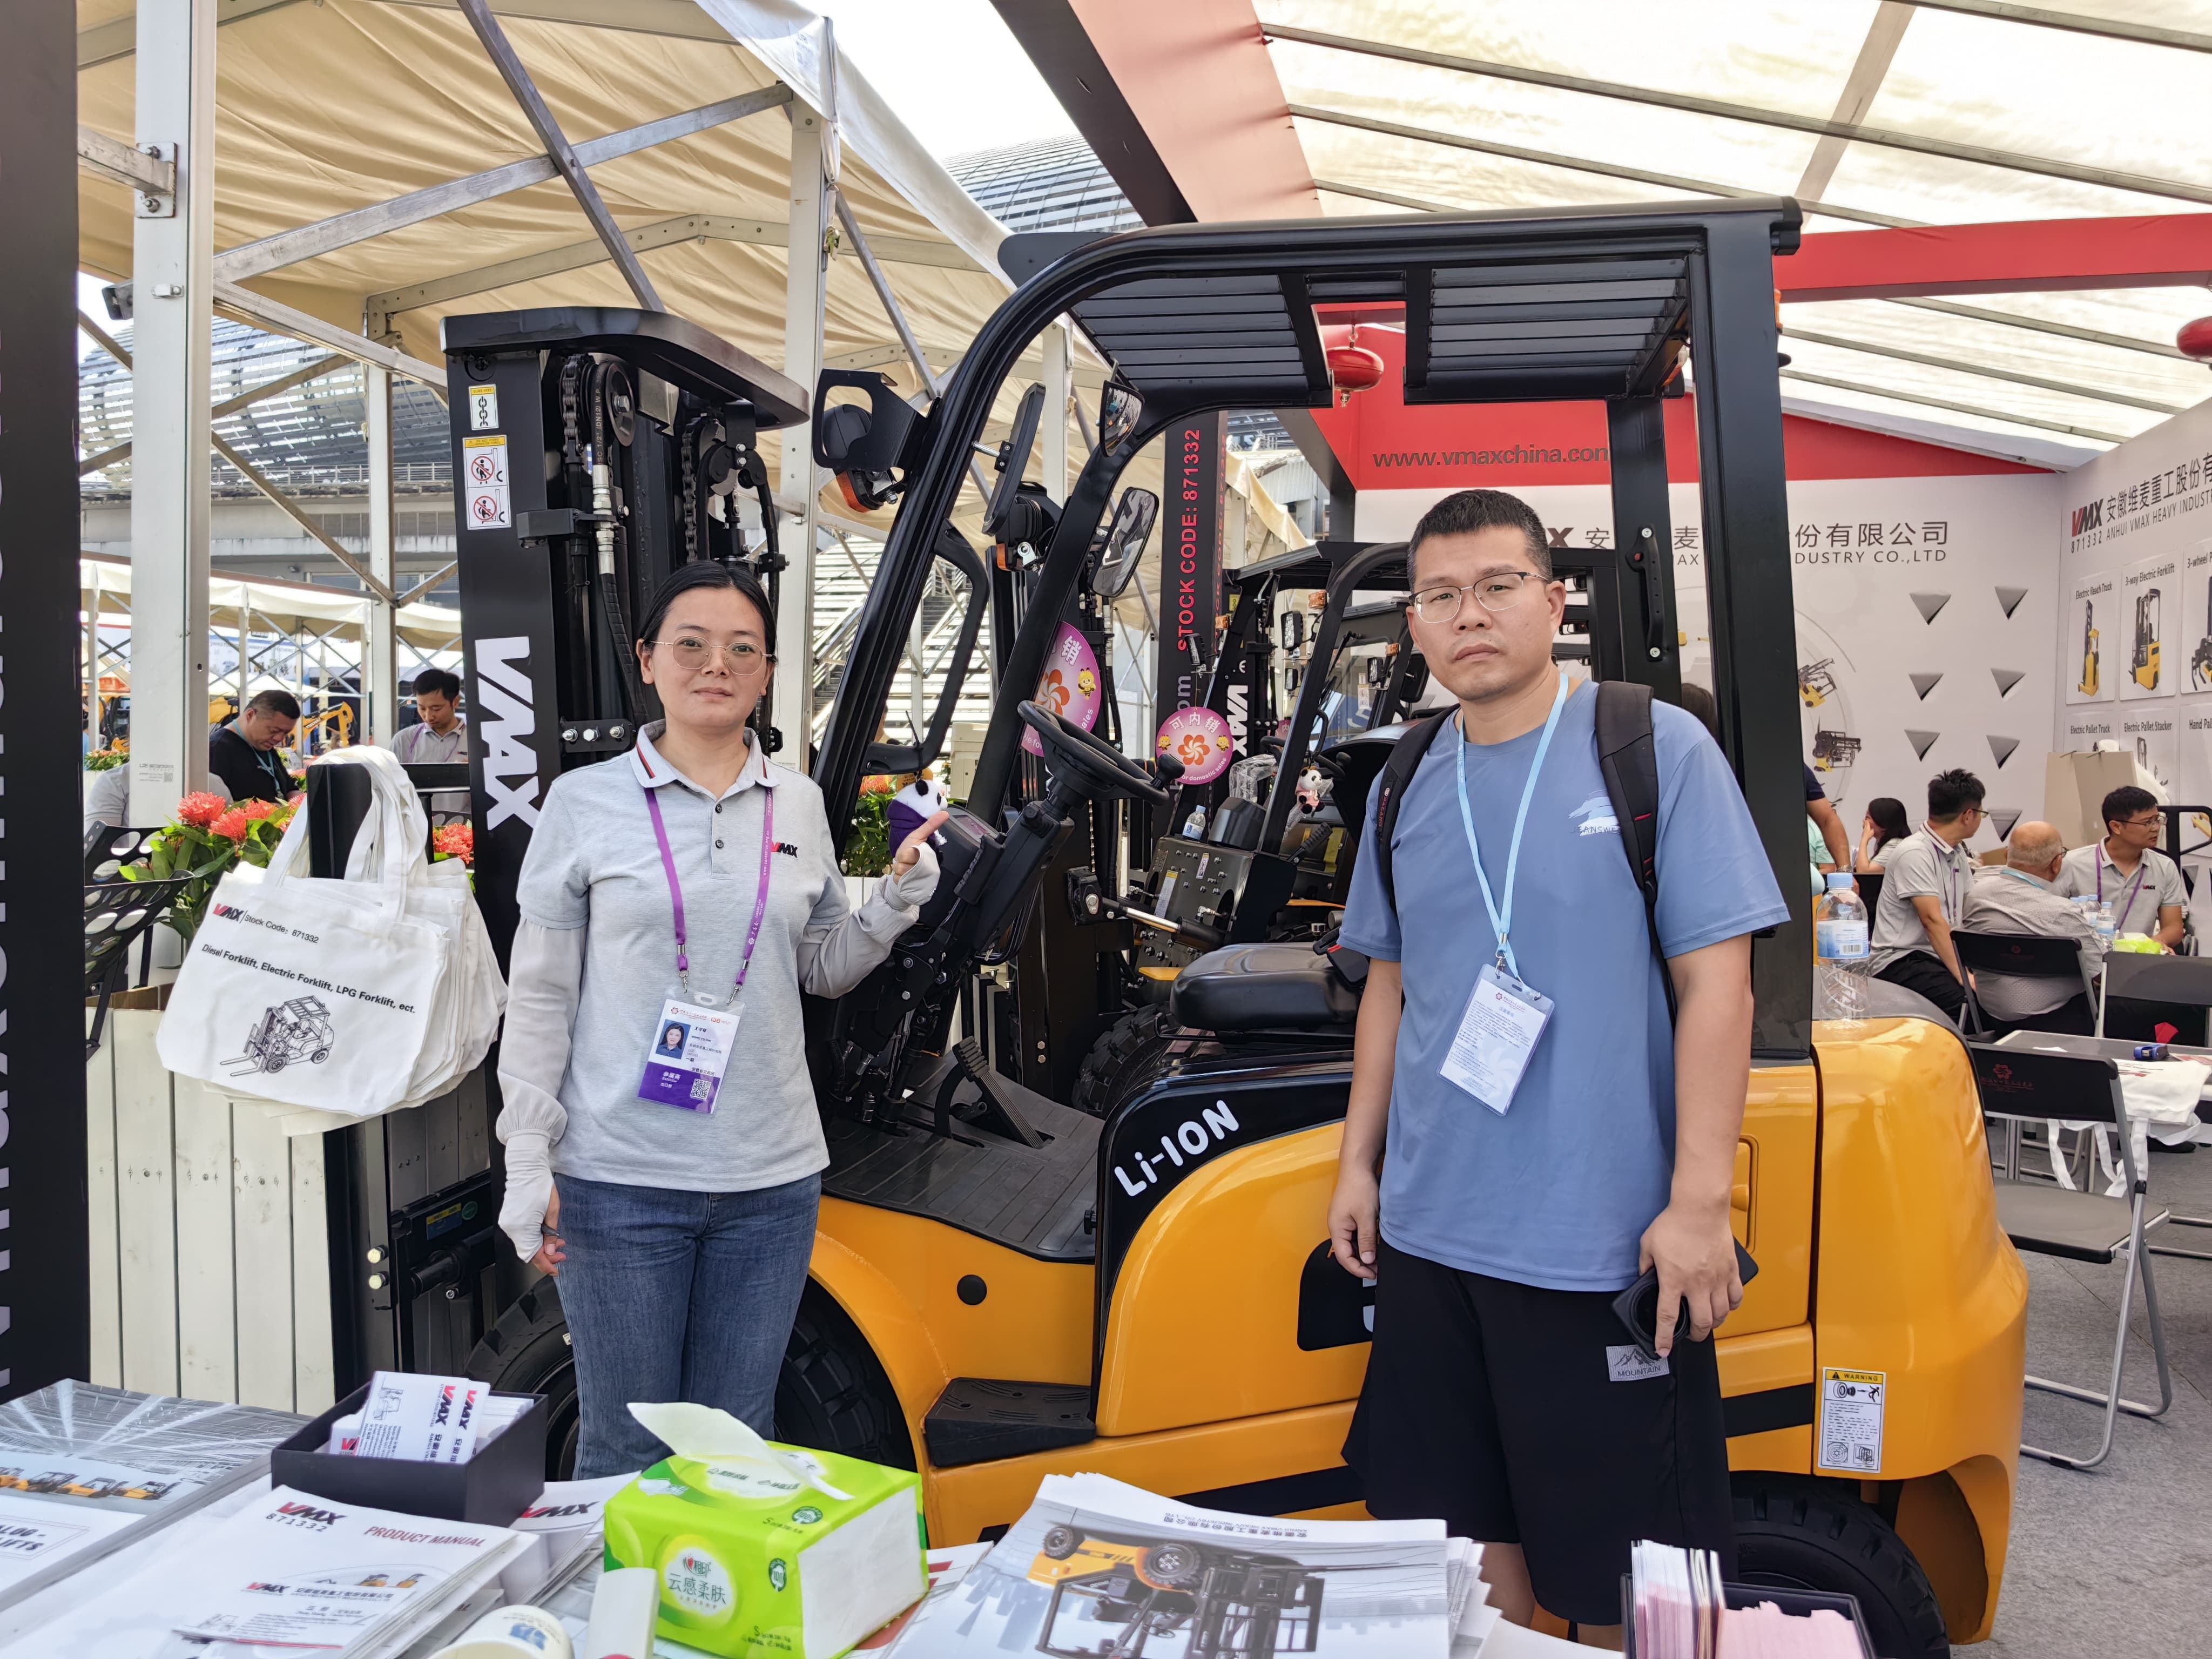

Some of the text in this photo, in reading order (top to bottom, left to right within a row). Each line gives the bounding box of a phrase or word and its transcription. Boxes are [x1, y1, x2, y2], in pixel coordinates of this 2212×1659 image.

[2107, 521, 2127, 540] ANHUI
[2130, 514, 2149, 532] VMAX
[2153, 502, 2177, 524] HEAVY
[1178, 430, 1199, 651] STOCK CODE: 871332
[2071, 531, 2102, 554] 871332
[1874, 550, 1946, 564] CO.,LTD
[2187, 552, 2208, 569] 3-wheel
[2126, 563, 2175, 586] 3-way Electric Forklift
[2075, 581, 2112, 599] Electric Reach Truck
[1082, 709, 1094, 730] ales
[2071, 724, 2110, 734] Electric Pallet Truck
[2124, 720, 2172, 732] Electric Pallet Stacker
[2189, 718, 2202, 730] Hand
[1189, 769, 1216, 781] domestic
[1215, 758, 1227, 772] sales
[244, 914, 265, 926] Stock
[292, 928, 319, 944] 871332
[202, 943, 416, 1014] Diesel Forklift, Electric Forklift, LPG Forklift, ect.
[1114, 1100, 1239, 1196] Li-ION
[1617, 1365, 1661, 1377] MOUNTAIN
[1844, 1373, 1878, 1381] WARNING
[266, 1513, 328, 1533] 871332
[364, 1526, 487, 1548] PRODUCT MANUAL
[668, 1573, 726, 1604] 云感柔肤
